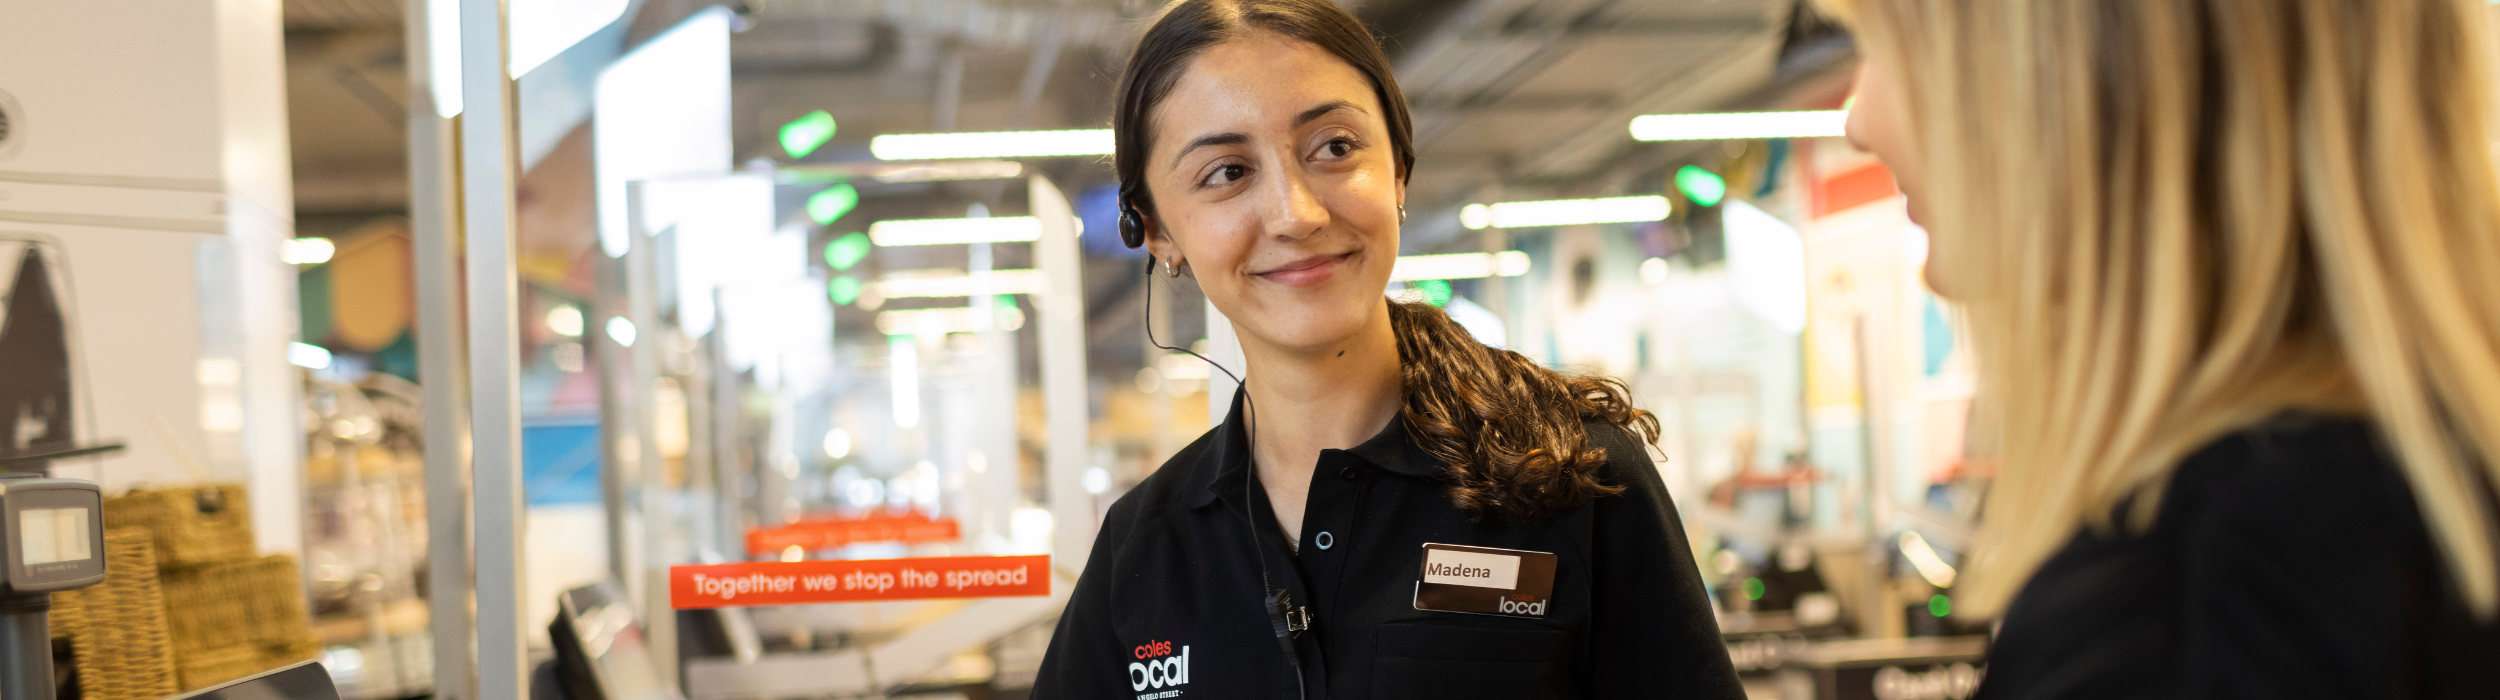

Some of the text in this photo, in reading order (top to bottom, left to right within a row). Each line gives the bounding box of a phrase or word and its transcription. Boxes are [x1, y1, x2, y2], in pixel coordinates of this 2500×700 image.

[1427, 563, 1491, 578] Madena
[693, 565, 1028, 600] Together we stop the spread
[1499, 596, 1546, 615] local
[1511, 593, 1535, 601] coles
[1135, 639, 1171, 659] coles
[1129, 645, 1189, 691] ocal
[1159, 690, 1179, 699] STREET
